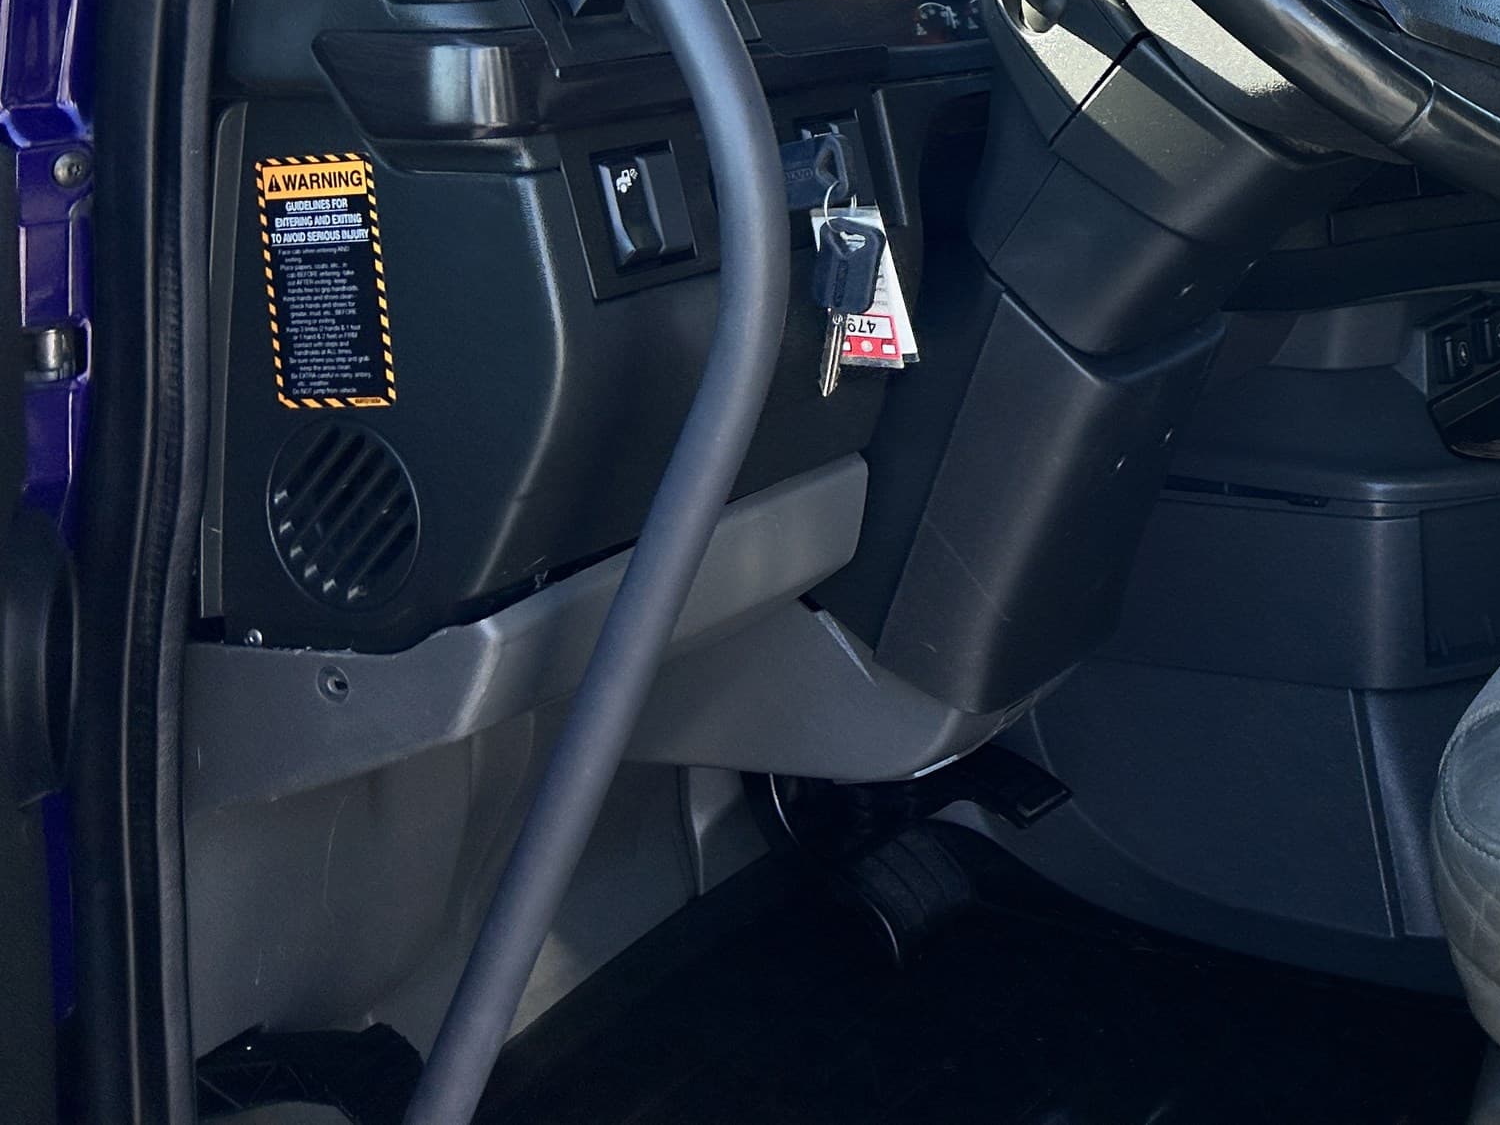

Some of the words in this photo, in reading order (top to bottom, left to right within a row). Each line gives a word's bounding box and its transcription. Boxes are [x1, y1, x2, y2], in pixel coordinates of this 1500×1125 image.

[283, 170, 363, 192] WARNING
[285, 199, 331, 212] GUIDELINES
[332, 198, 348, 209] FOR
[274, 215, 313, 228] ENTERING
[314, 215, 331, 226] AND
[332, 213, 362, 225] EXITING
[271, 234, 282, 244] TO
[282, 232, 306, 243] AVOID
[306, 230, 340, 242] SERIOUS
[341, 228, 370, 240] INJURY
